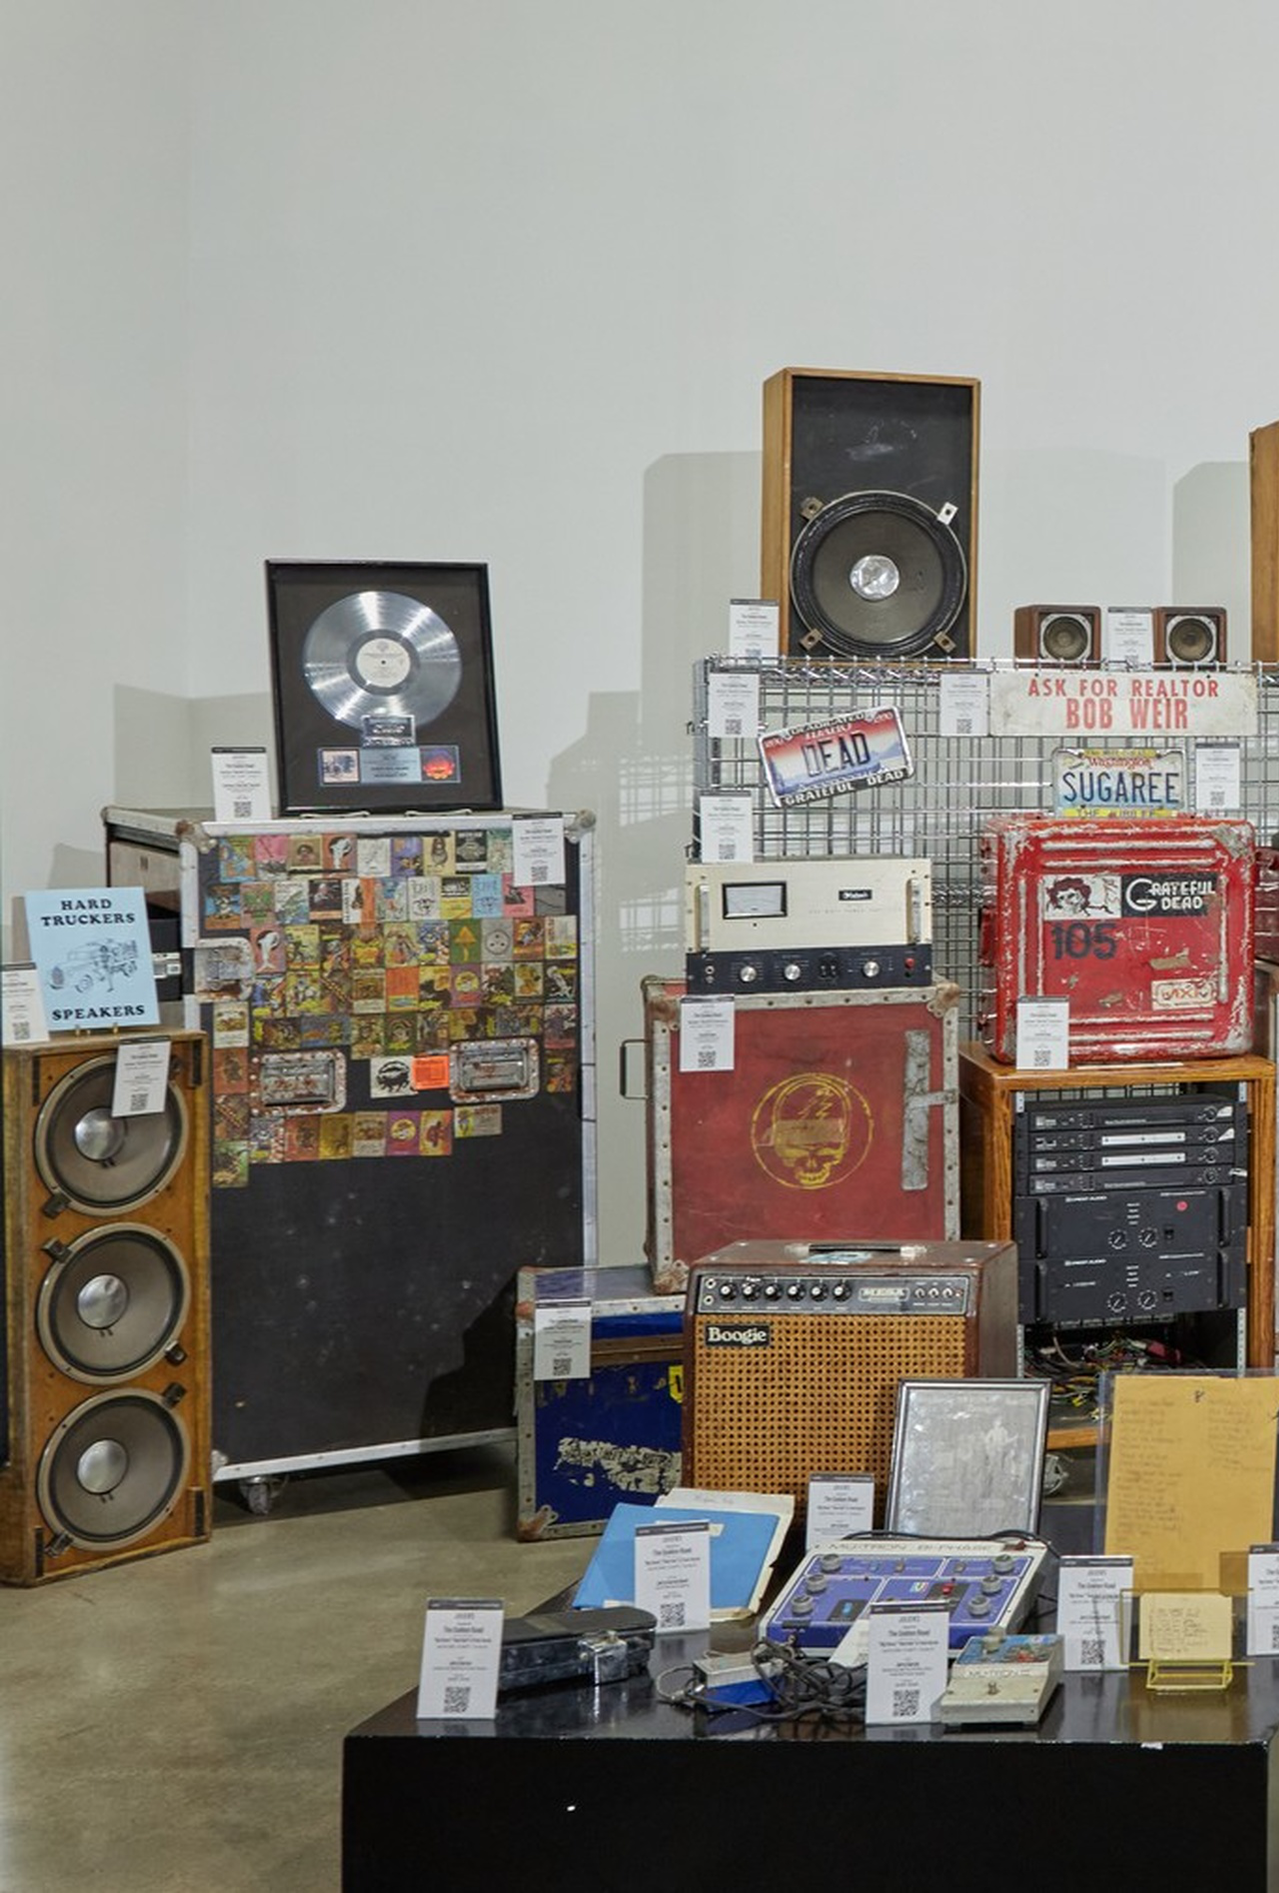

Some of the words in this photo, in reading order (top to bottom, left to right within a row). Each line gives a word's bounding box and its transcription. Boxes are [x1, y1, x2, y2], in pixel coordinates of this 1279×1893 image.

[1028, 678, 1066, 697] ASK
[1080, 678, 1118, 697] FOR
[1131, 679, 1219, 698] REALTOR
[1065, 698, 1114, 729] BOB
[1130, 698, 1188, 730] WEIR
[801, 730, 872, 778] DEAD
[784, 781, 856, 806] GRATEFUL
[866, 769, 905, 787] DEAD
[1062, 771, 1180, 804] SUGAREE
[60, 898, 112, 911] HARD
[1125, 878, 1216, 912] GRATEFUL
[1161, 897, 1203, 911] DEAD
[40, 912, 136, 927] TRUCKERS
[1051, 922, 1118, 961] 105
[51, 1004, 146, 1021] SPEAKERS
[707, 1326, 768, 1346] Boogie
